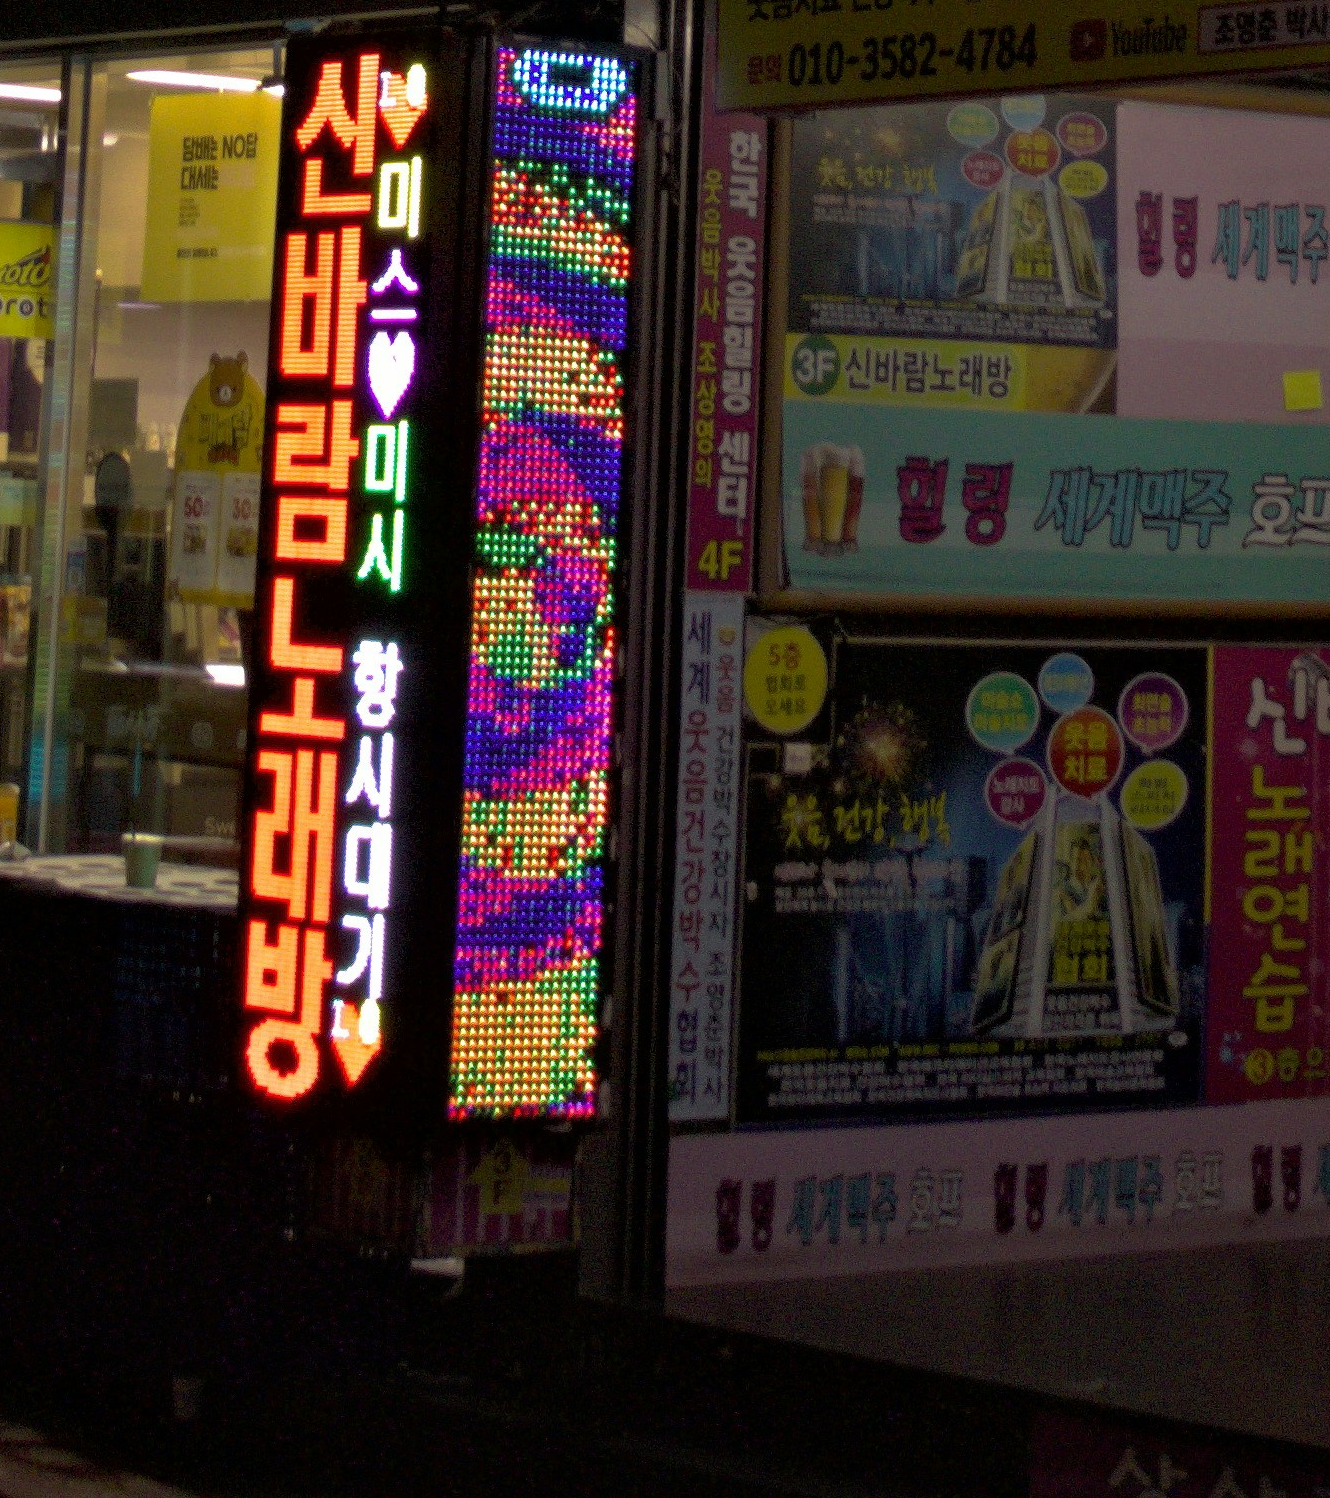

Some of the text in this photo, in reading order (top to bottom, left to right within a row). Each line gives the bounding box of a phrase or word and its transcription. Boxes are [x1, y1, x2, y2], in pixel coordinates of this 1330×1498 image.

[788, 21, 1038, 89] 010-3582-4784
[1111, 16, 1188, 58] YouTube
[181, 135, 219, 163] 담배는
[363, 155, 422, 322] 미스
[792, 344, 1013, 397] 3F 신바람노래방
[716, 431, 752, 536] 센터
[896, 454, 1015, 547] 힐링
[1034, 466, 1233, 552] 세계맥주
[243, 53, 381, 1101] 신바람노래방
[697, 539, 744, 582] 4F
[1064, 753, 1109, 784] 치료
[335, 639, 405, 1003] 항시대기
[1241, 763, 1315, 1034] 노래연습
